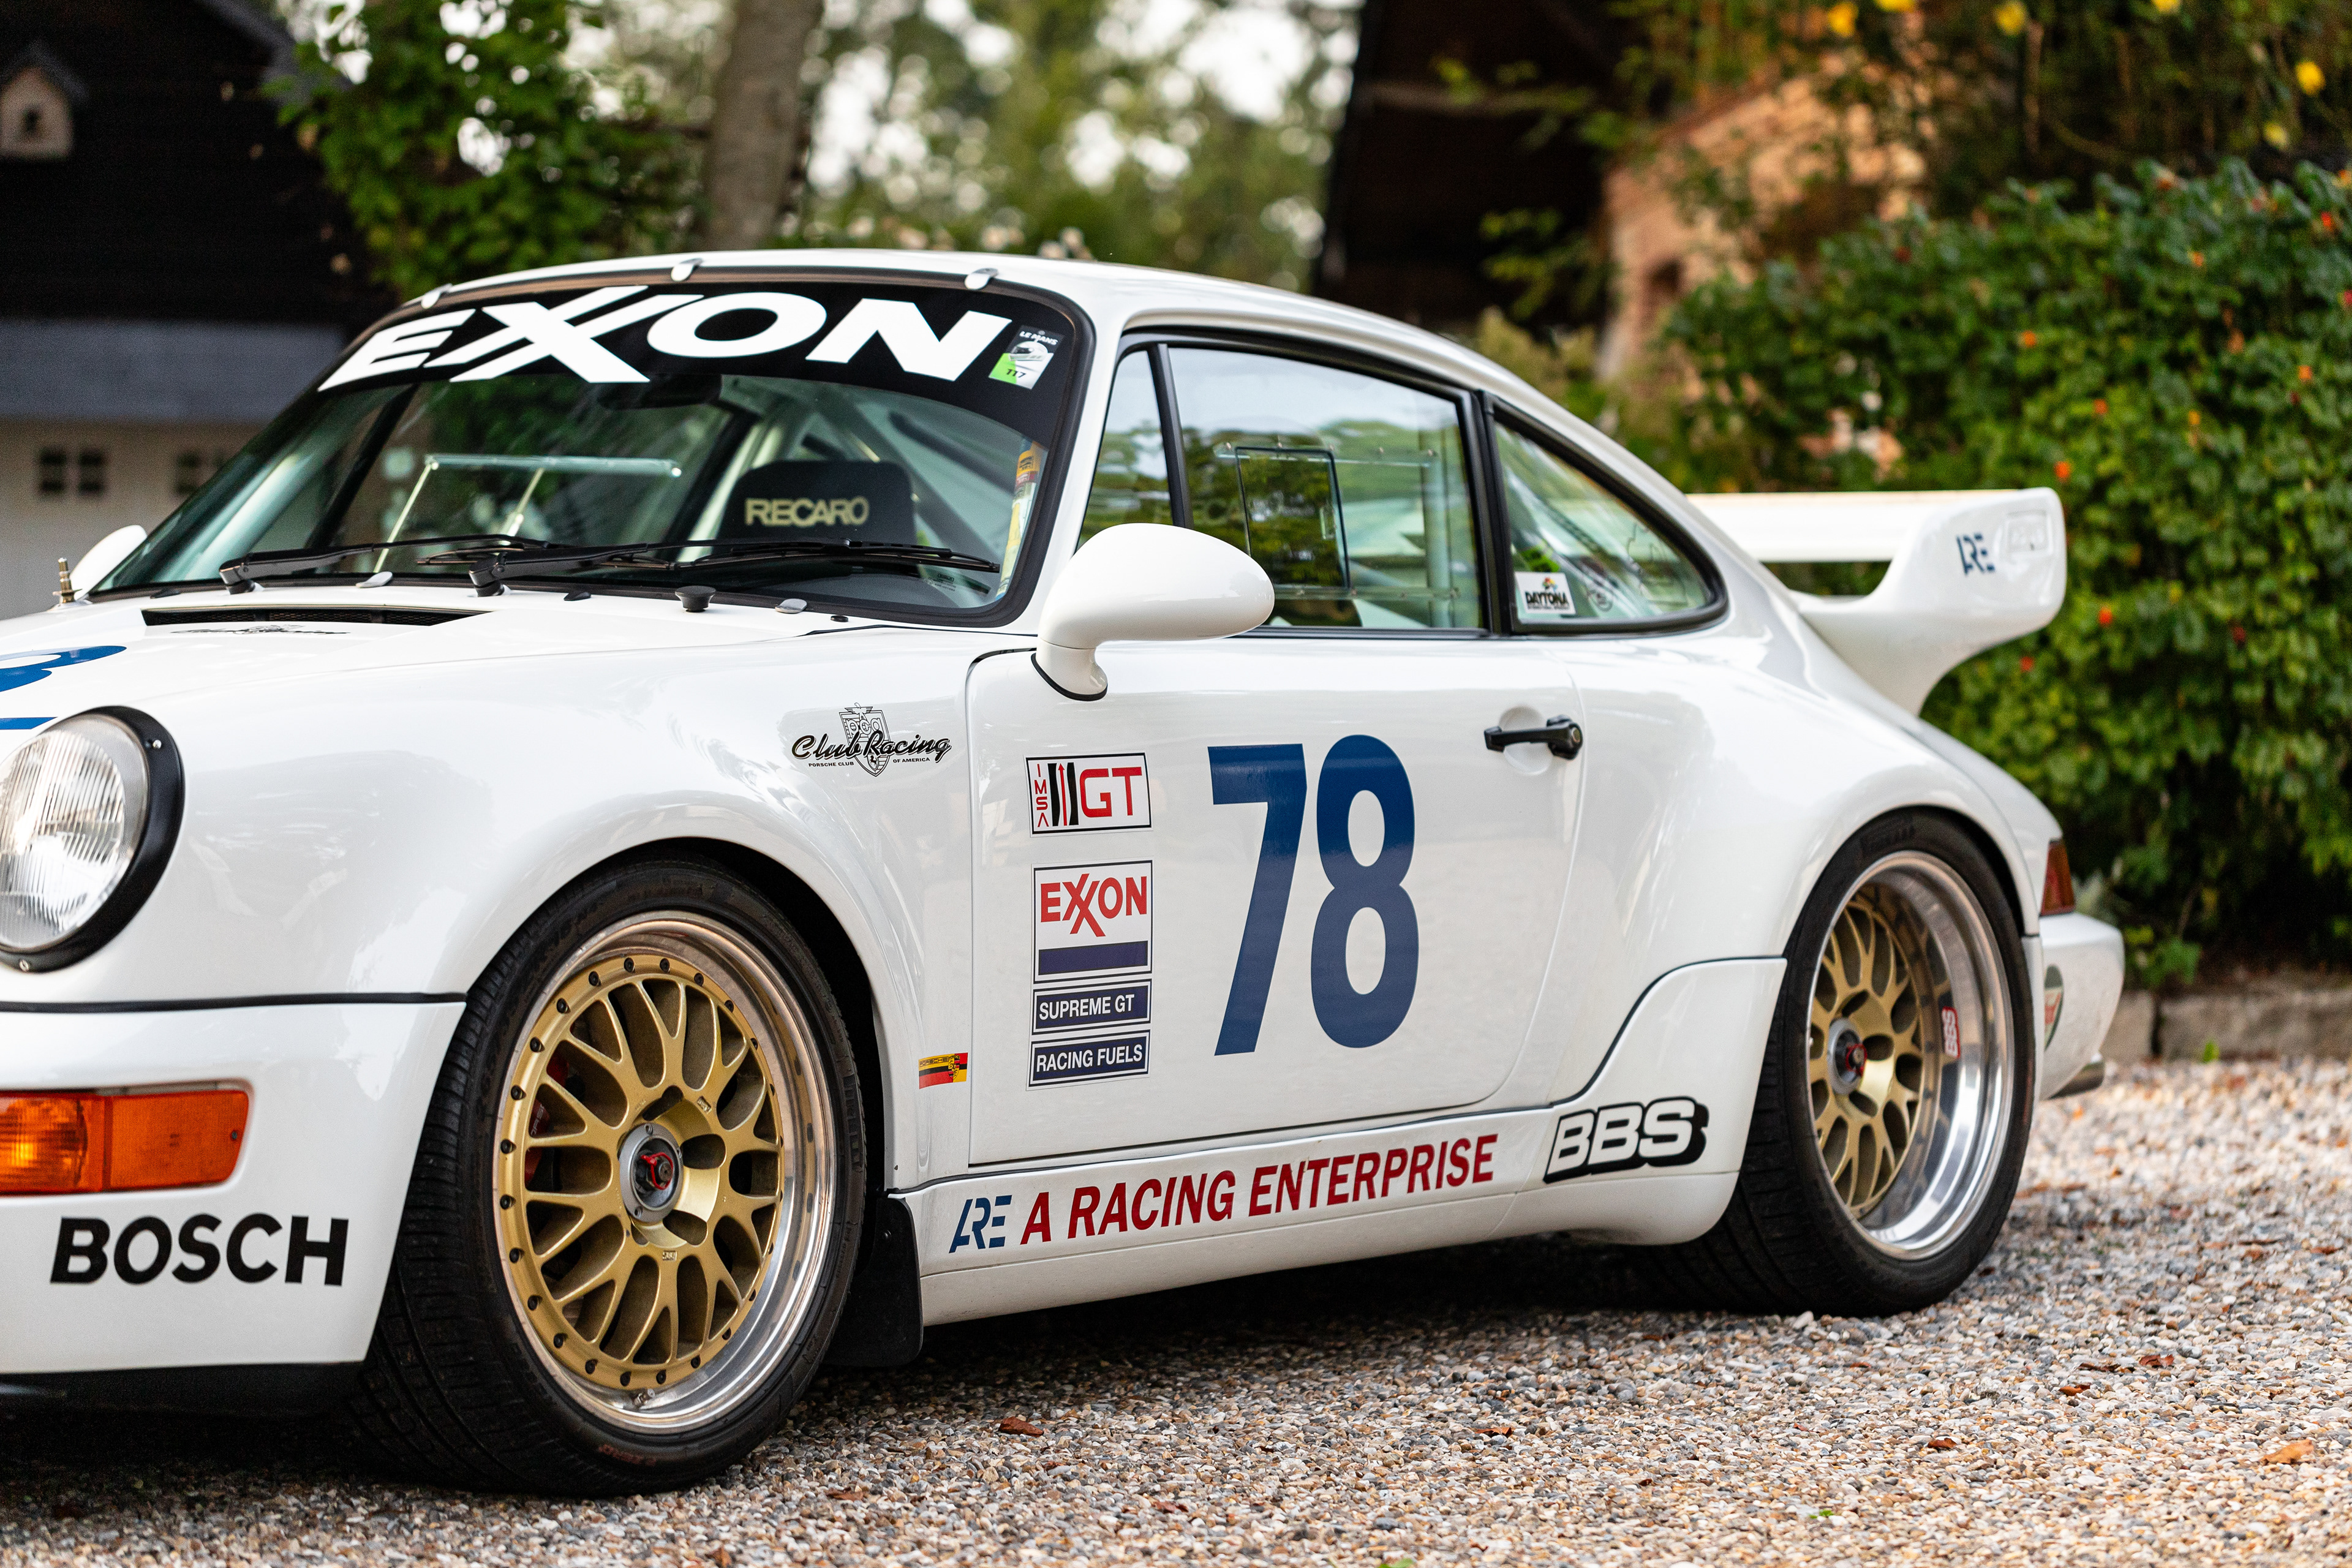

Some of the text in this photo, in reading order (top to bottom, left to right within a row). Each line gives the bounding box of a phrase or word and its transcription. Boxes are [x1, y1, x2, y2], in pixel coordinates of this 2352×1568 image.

[318, 285, 1012, 391] EXXON
[1032, 334, 1058, 345] MANS
[744, 496, 869, 527] RECARO
[1525, 591, 1569, 605] DAYTONA
[791, 730, 952, 763] Club Racing
[1034, 763, 1049, 827] IMSA
[1079, 766, 1143, 818] GT
[1040, 873, 1147, 938] EXXON
[1208, 734, 1419, 1056] 78
[1038, 993, 1135, 1020] SUPREME GT
[1036, 1044, 1143, 1072] RACING FUELS
[1543, 1096, 1709, 1184] BBS
[1020, 1192, 1052, 1245] A
[1068, 1170, 1235, 1239] RACING
[1248, 1134, 1498, 1217] ENTERPRISE
[50, 1213, 349, 1286] BOSCH
